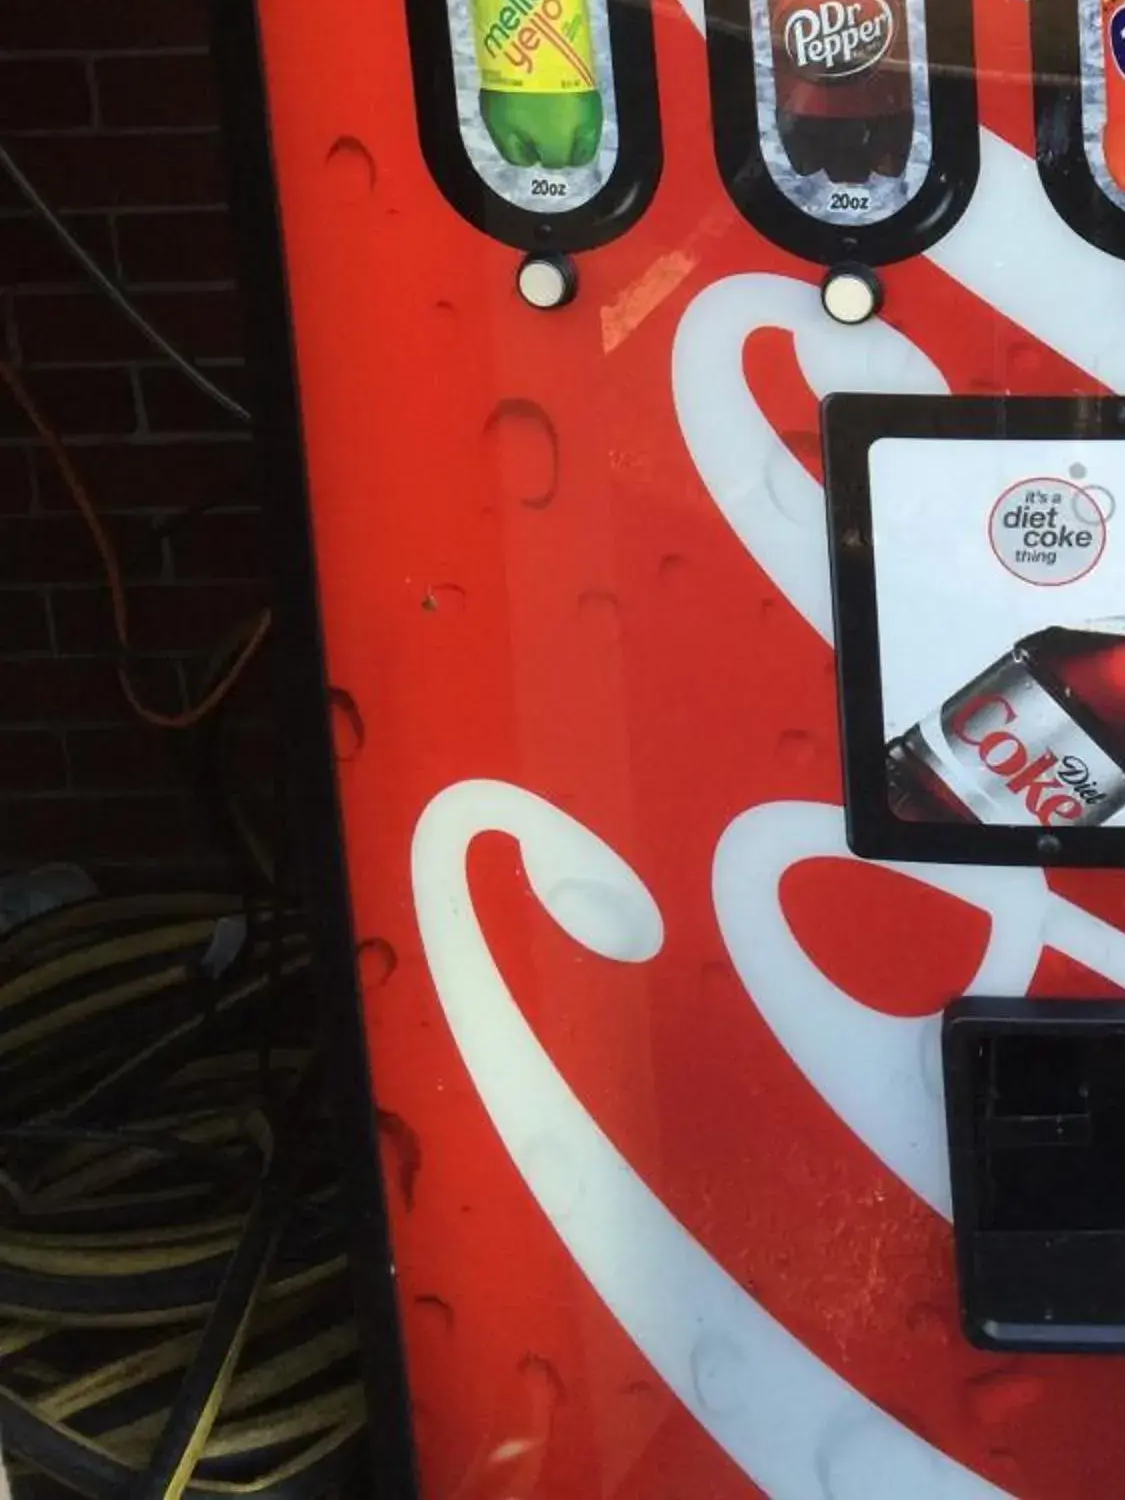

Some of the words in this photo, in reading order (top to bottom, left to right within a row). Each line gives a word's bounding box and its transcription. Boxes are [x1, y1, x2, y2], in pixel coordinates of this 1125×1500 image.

[819, 1, 863, 35] Dr
[785, 9, 887, 68] Pepper
[531, 179, 567, 197] 20oz
[830, 193, 870, 211] 20oz
[1025, 490, 1048, 504] it's
[1051, 493, 1062, 504] a
[1003, 505, 1059, 529] diet
[1023, 525, 1093, 548] coke
[1015, 550, 1057, 565] thing
[953, 694, 1083, 827] Coke
[1057, 755, 1109, 804] Diet
